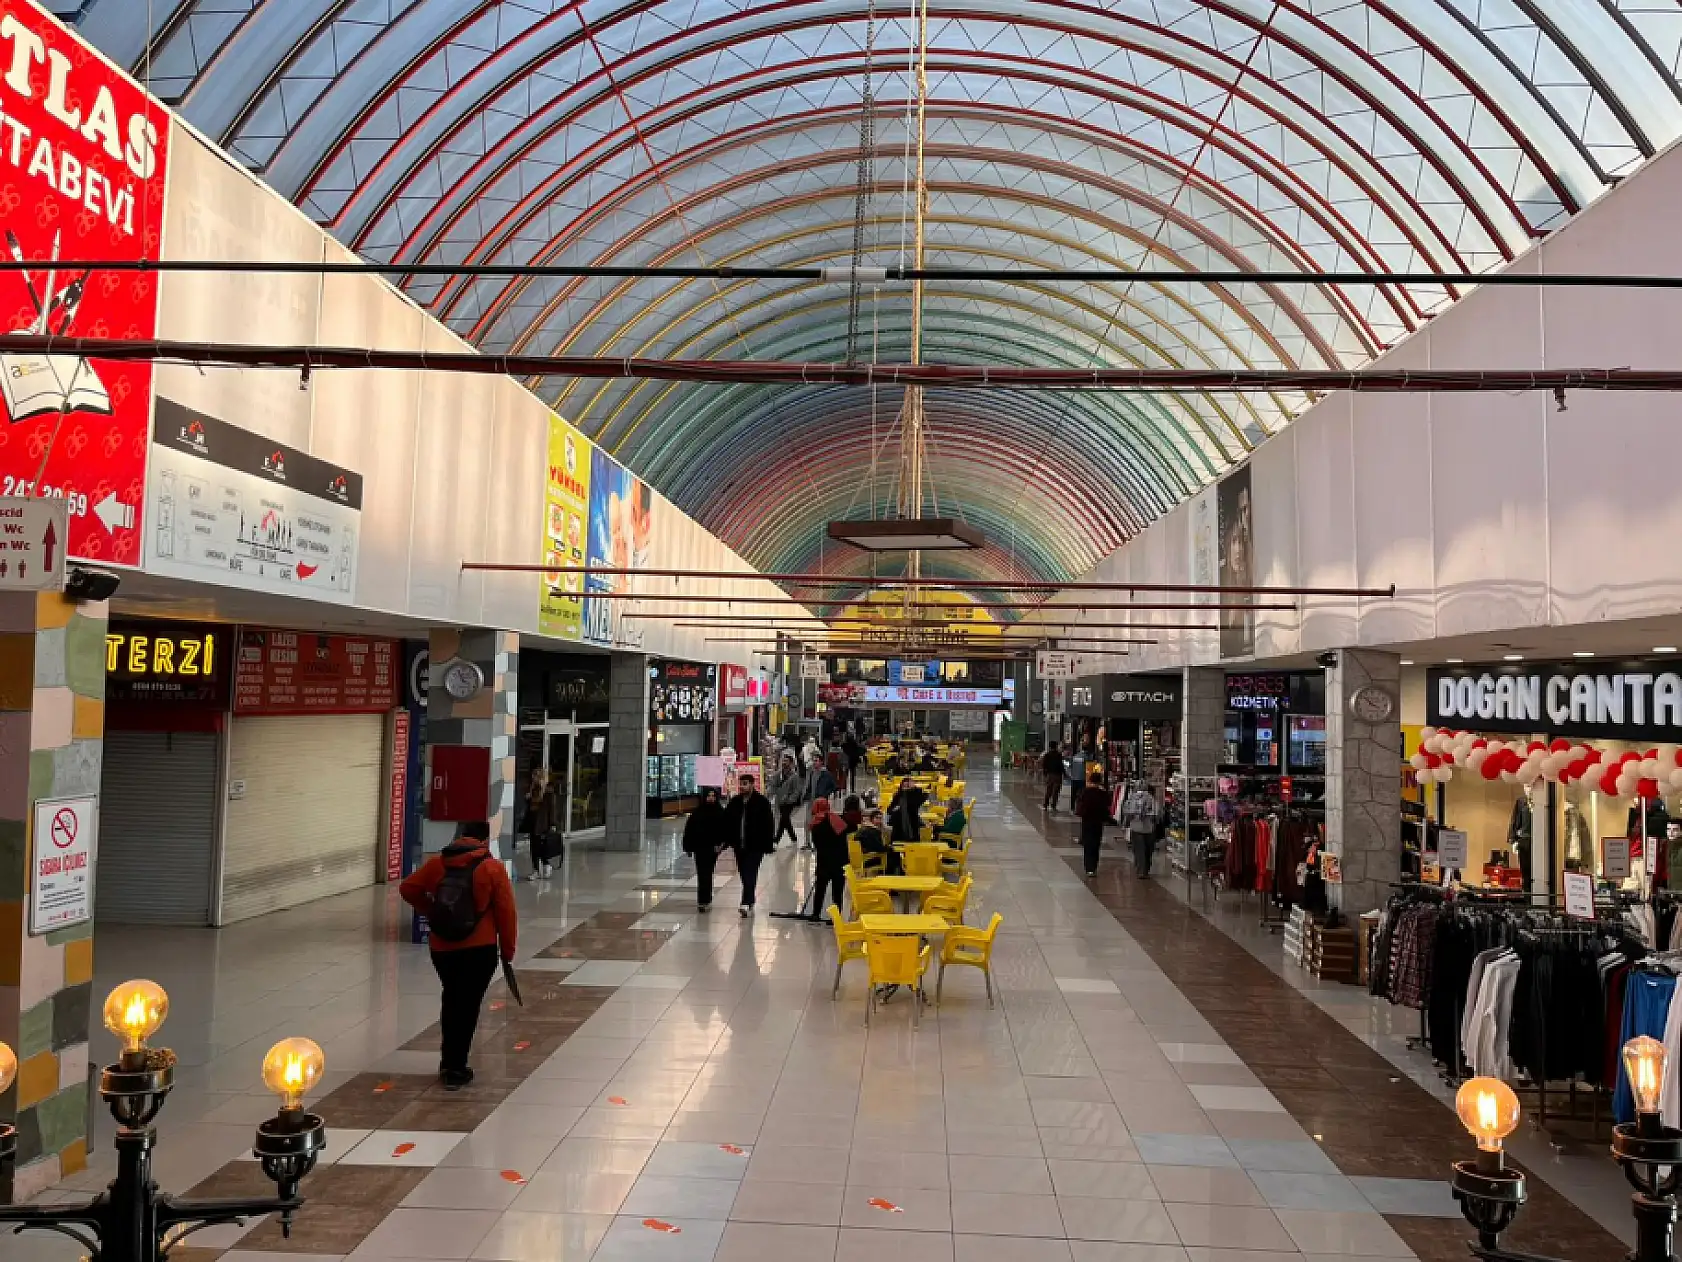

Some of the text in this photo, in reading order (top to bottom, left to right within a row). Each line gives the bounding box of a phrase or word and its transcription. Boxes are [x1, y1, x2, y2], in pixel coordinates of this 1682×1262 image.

[105, 634, 214, 675] TERZİ
[1438, 672, 1682, 726] DOĞAN ÇANTA
